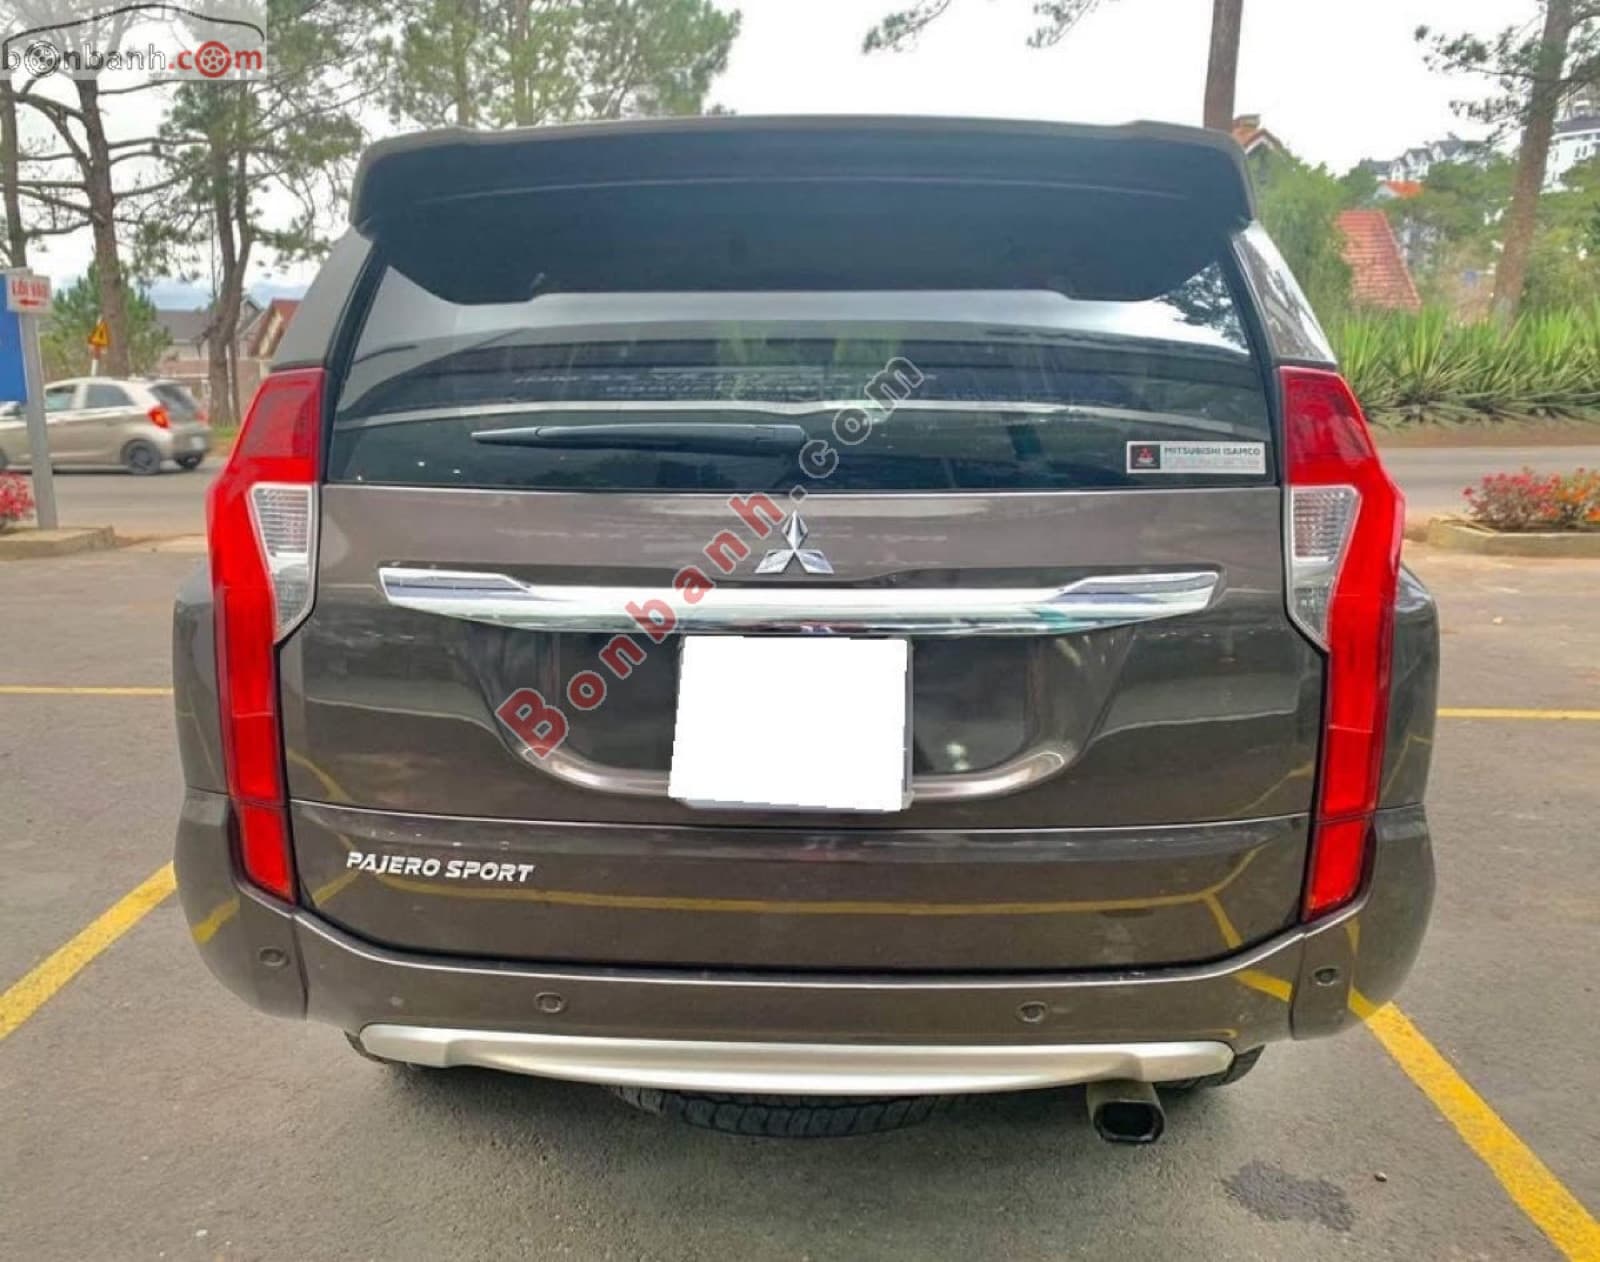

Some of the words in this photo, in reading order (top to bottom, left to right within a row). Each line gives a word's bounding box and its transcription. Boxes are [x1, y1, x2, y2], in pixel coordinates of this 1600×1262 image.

[1164, 447, 1221, 456] MITSUBISHI
[346, 851, 441, 876] PAJERO
[445, 860, 535, 882] SPORT
